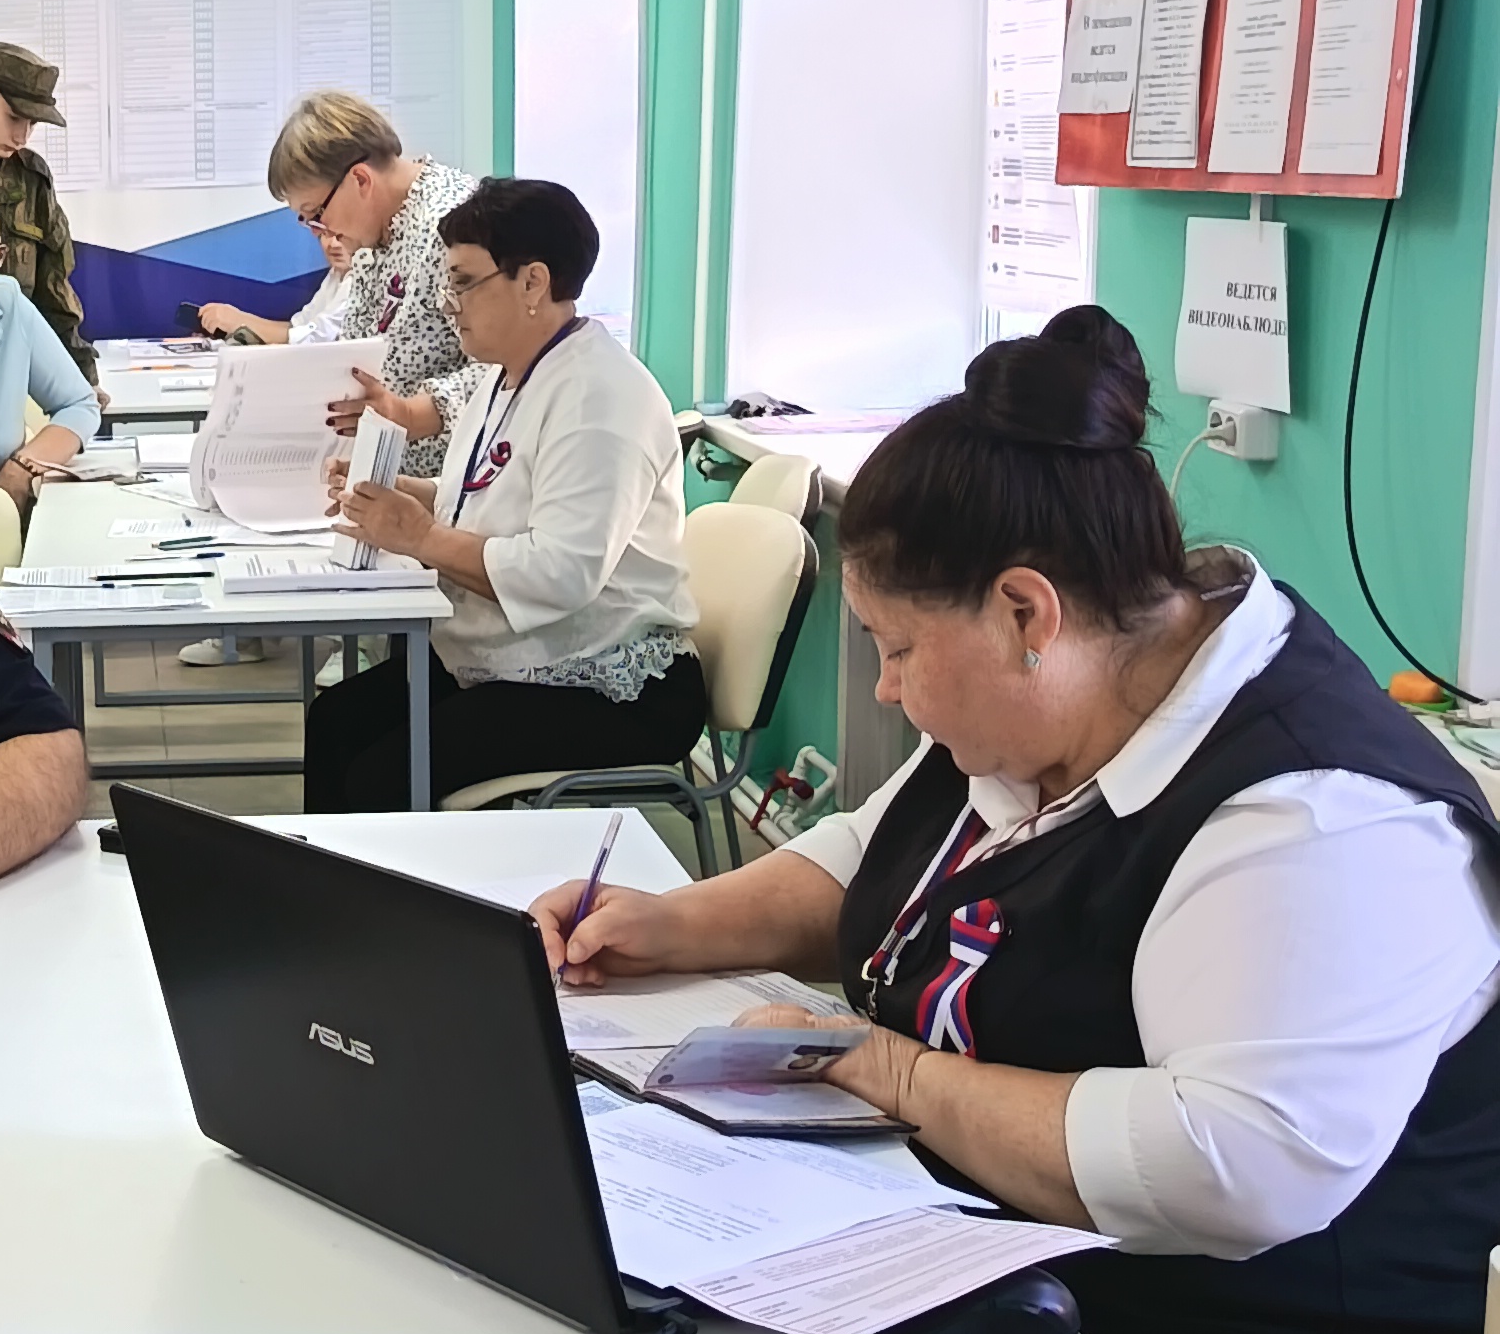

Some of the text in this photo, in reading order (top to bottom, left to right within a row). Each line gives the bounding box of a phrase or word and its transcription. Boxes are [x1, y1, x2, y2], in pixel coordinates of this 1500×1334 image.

[1226, 282, 1277, 302] ВЕДЕТСЯ
[1188, 309, 1286, 336] ВИДЕОНАБЛЮДЕ
[309, 1022, 375, 1065] ASUS
